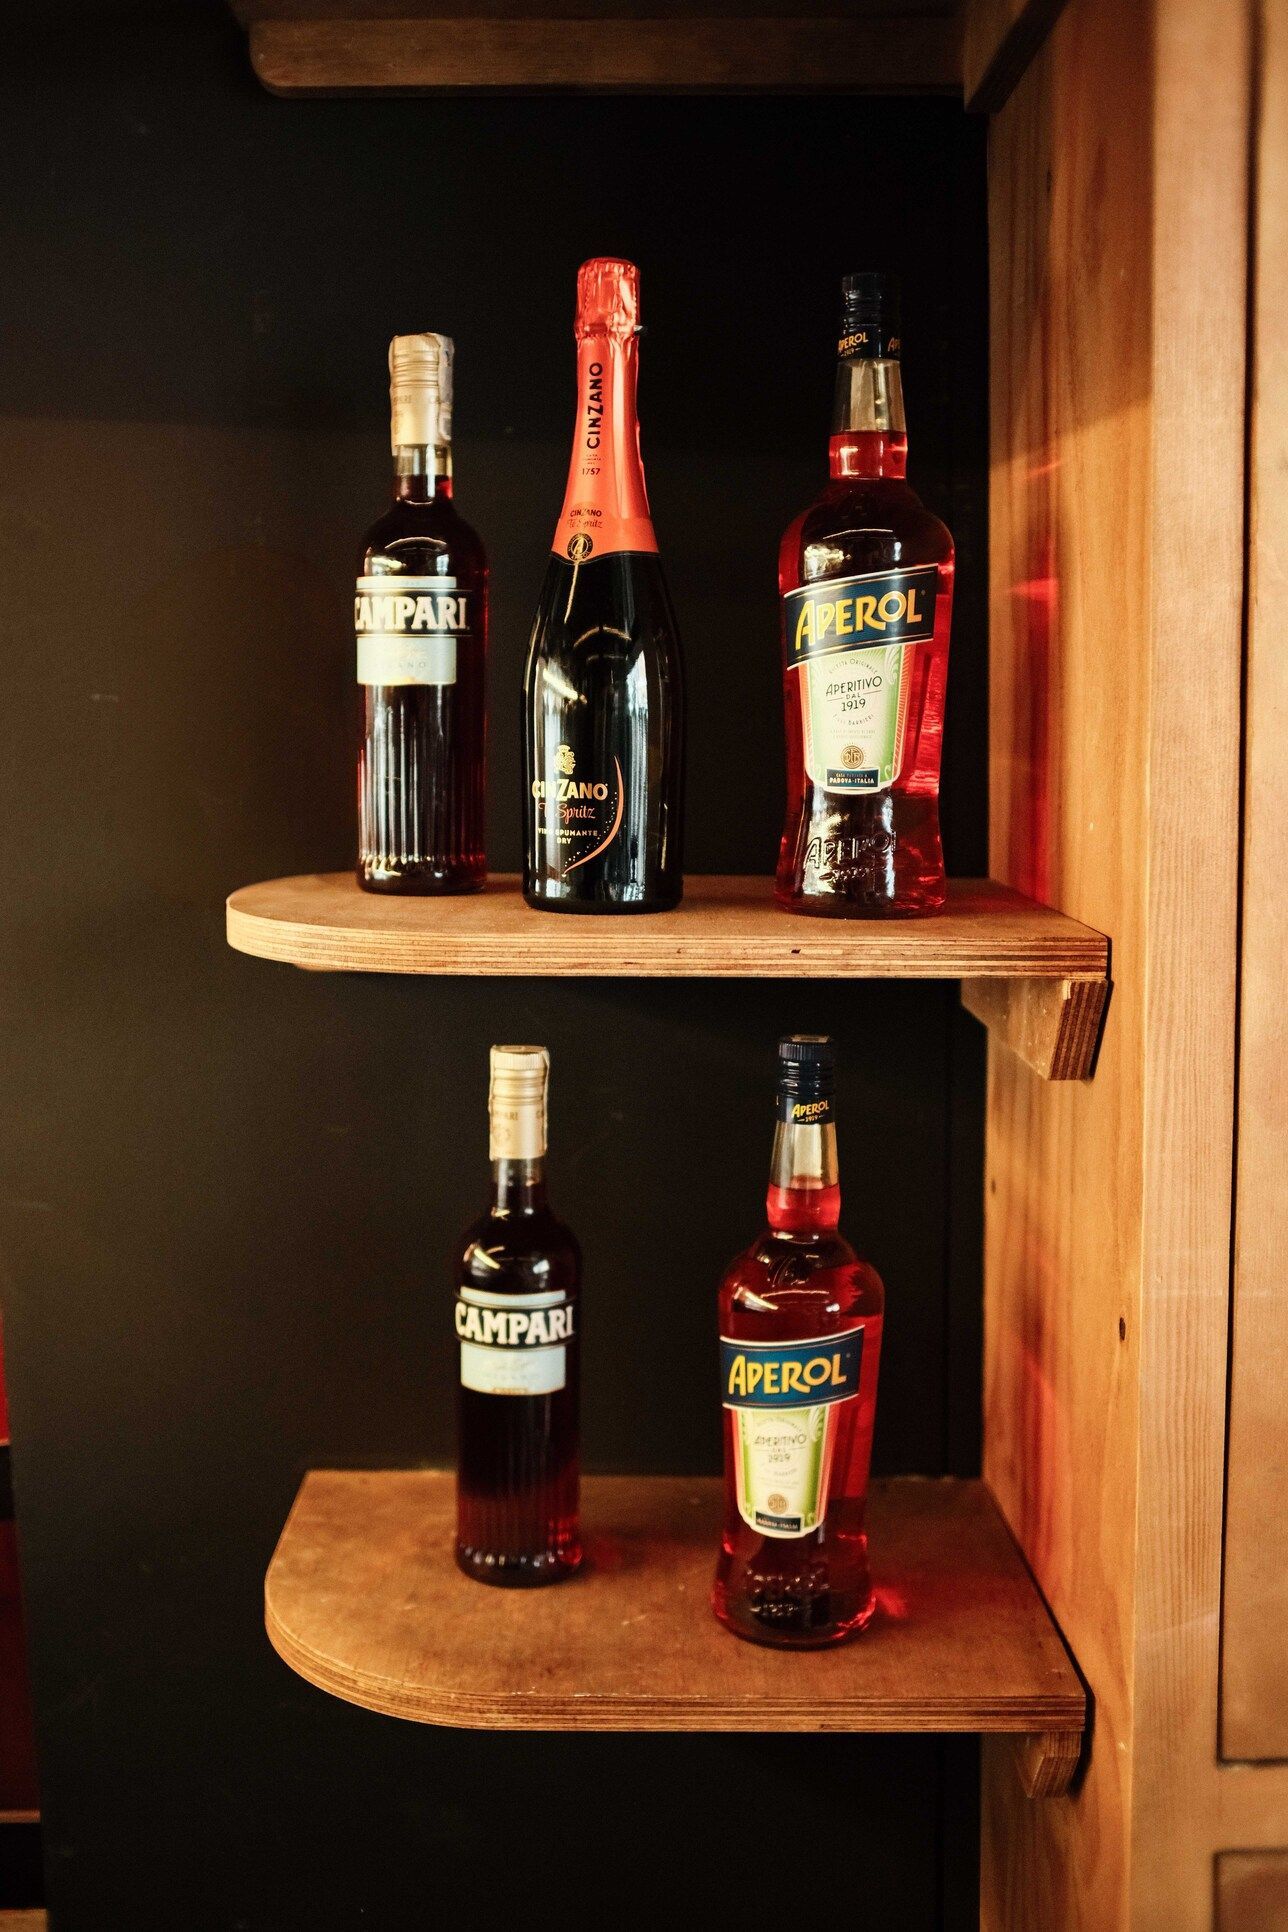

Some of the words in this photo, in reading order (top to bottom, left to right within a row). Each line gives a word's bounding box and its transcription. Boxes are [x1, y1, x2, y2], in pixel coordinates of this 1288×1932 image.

[586, 362, 604, 449] CINZANO
[582, 467, 601, 475] 1757
[795, 588, 923, 650] APEROL
[825, 675, 883, 697] APERITIVO
[841, 698, 866, 712] 1919
[532, 779, 608, 802] CINZANO
[555, 803, 596, 825] Spritz
[556, 829, 598, 837] SPUMANTE
[557, 837, 572, 845] DRY
[791, 1100, 830, 1118] APEROL
[455, 1301, 575, 1345] CAMPARI
[728, 1353, 847, 1396] APEROL
